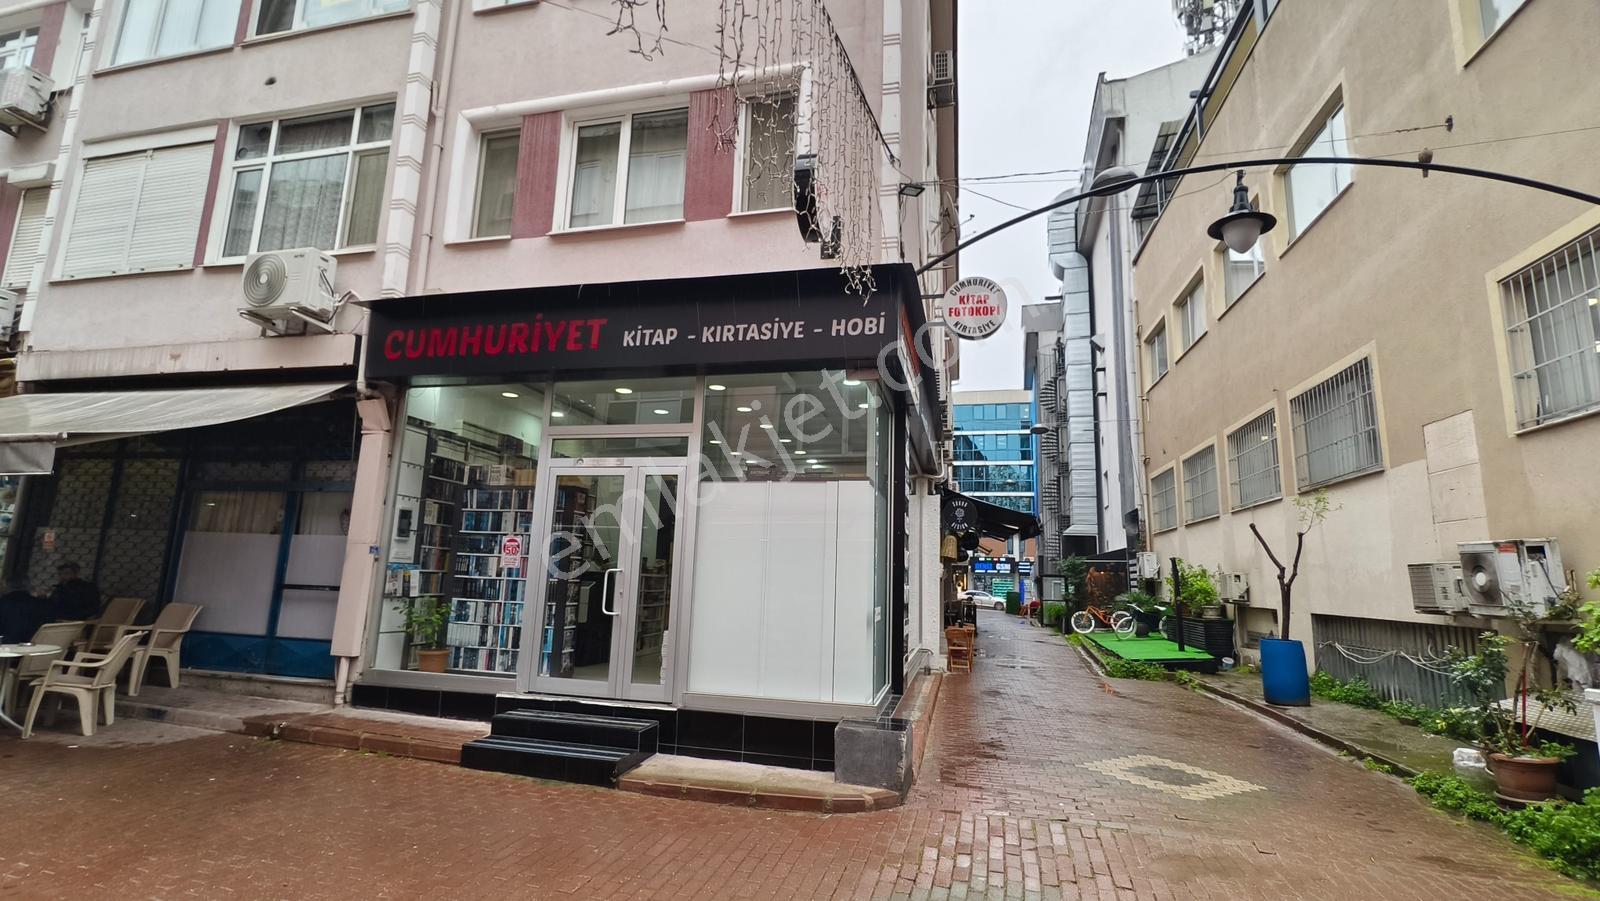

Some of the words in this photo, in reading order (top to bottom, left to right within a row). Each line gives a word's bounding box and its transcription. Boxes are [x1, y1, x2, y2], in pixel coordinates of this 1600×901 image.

[384, 314, 608, 361] CUMHURİYET
[623, 325, 678, 347] KİTAP
[701, 319, 805, 343] KIRTASİYE
[831, 311, 886, 337] HOBİ
